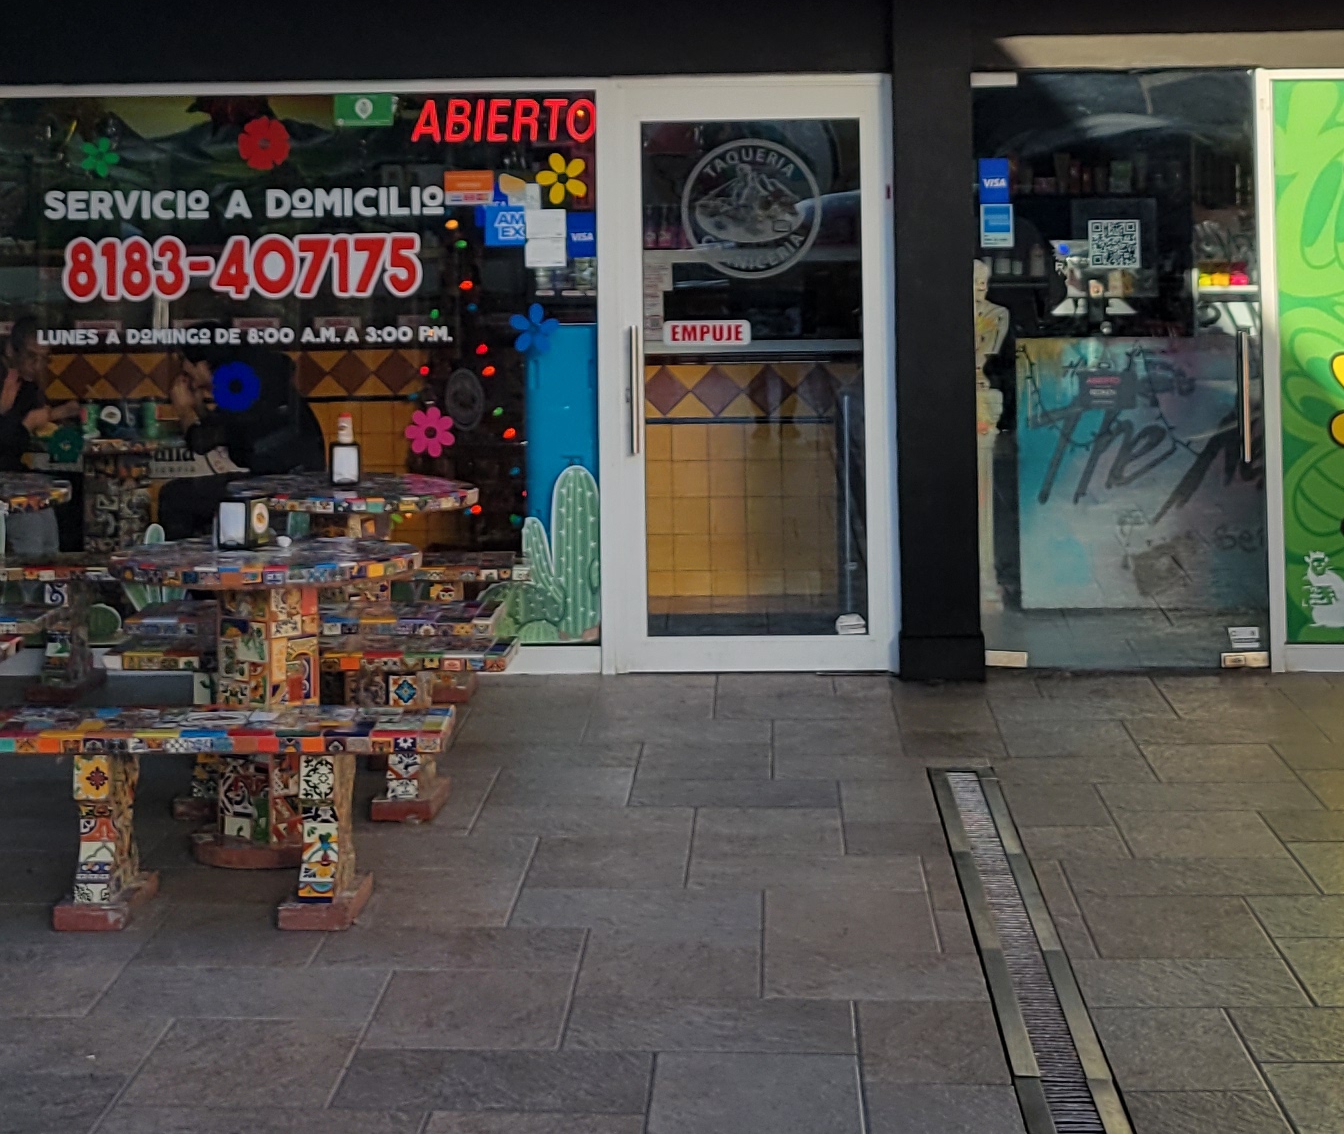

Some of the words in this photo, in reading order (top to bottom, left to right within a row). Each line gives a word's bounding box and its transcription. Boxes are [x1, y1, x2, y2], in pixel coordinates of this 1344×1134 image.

[411, 99, 596, 143] ABIERTO
[702, 147, 796, 178] TAQUERIA
[983, 177, 1008, 188] VISA
[44, 189, 210, 220] SERVICIO
[225, 190, 253, 220] A
[265, 184, 445, 219] DOMICILIO
[570, 232, 594, 243] VISA
[62, 232, 423, 303] 8183-407175
[37, 329, 100, 346] LUNES
[105, 330, 121, 345] A
[126, 328, 211, 345] DOMINGO
[215, 329, 242, 345] DE
[247, 328, 295, 345] 8:00
[300, 327, 341, 343] A.M.
[344, 327, 360, 343] A
[365, 326, 412, 343] 3:00
[418, 325, 454, 343] P.M.
[670, 323, 744, 342] EMPUJE
